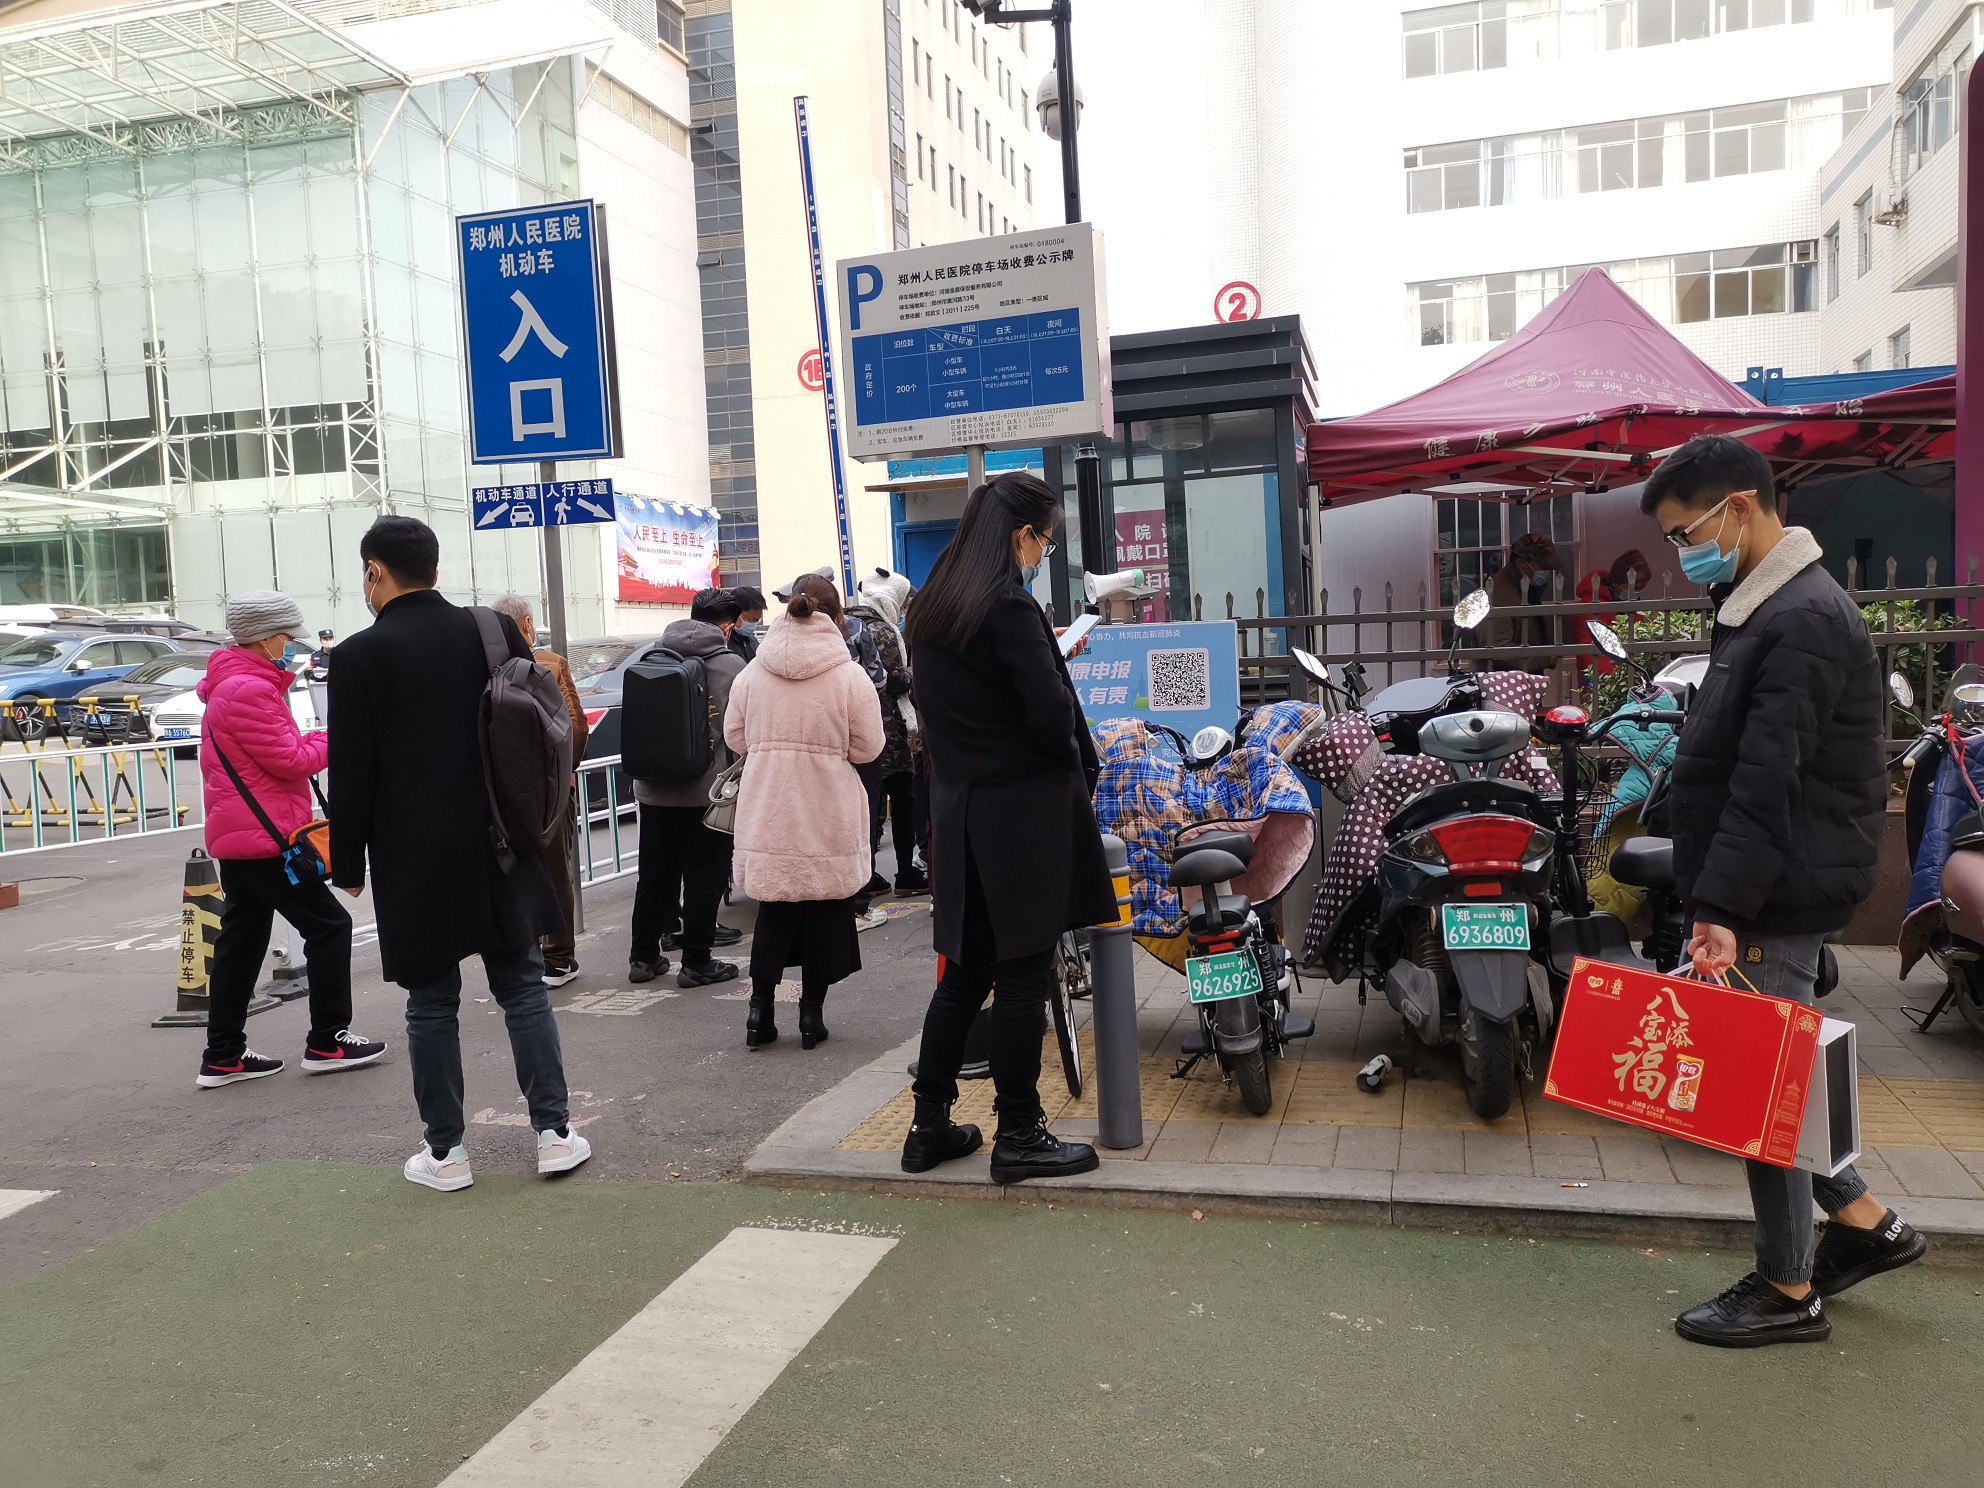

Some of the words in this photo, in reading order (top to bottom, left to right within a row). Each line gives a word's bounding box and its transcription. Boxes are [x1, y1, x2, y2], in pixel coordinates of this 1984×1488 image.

[469, 213, 583, 252] 郑州人民医院
[499, 248, 555, 279] 机动车
[897, 248, 1075, 286] 郑州人民医院停车场收费公示牌
[847, 264, 884, 331] P
[943, 332, 974, 347] 收费标准
[995, 325, 1012, 336] 白天
[893, 338, 915, 349] 泊位数
[499, 289, 569, 442] 入口
[864, 363, 874, 398] 政府定价
[896, 383, 918, 394] 200个
[475, 485, 538, 503] 机动车通道
[546, 481, 609, 498] 人行通道
[633, 524, 668, 544] 人民至上
[672, 529, 705, 548] 生命至上
[1456, 910, 1471, 922] 郑
[1500, 909, 1515, 923] 州
[181, 908, 195, 984] 禁止停车
[1449, 925, 1525, 945] 6936809
[1198, 962, 1212, 976] 郑
[1238, 953, 1250, 970] 州
[1192, 967, 1259, 997] 9626925
